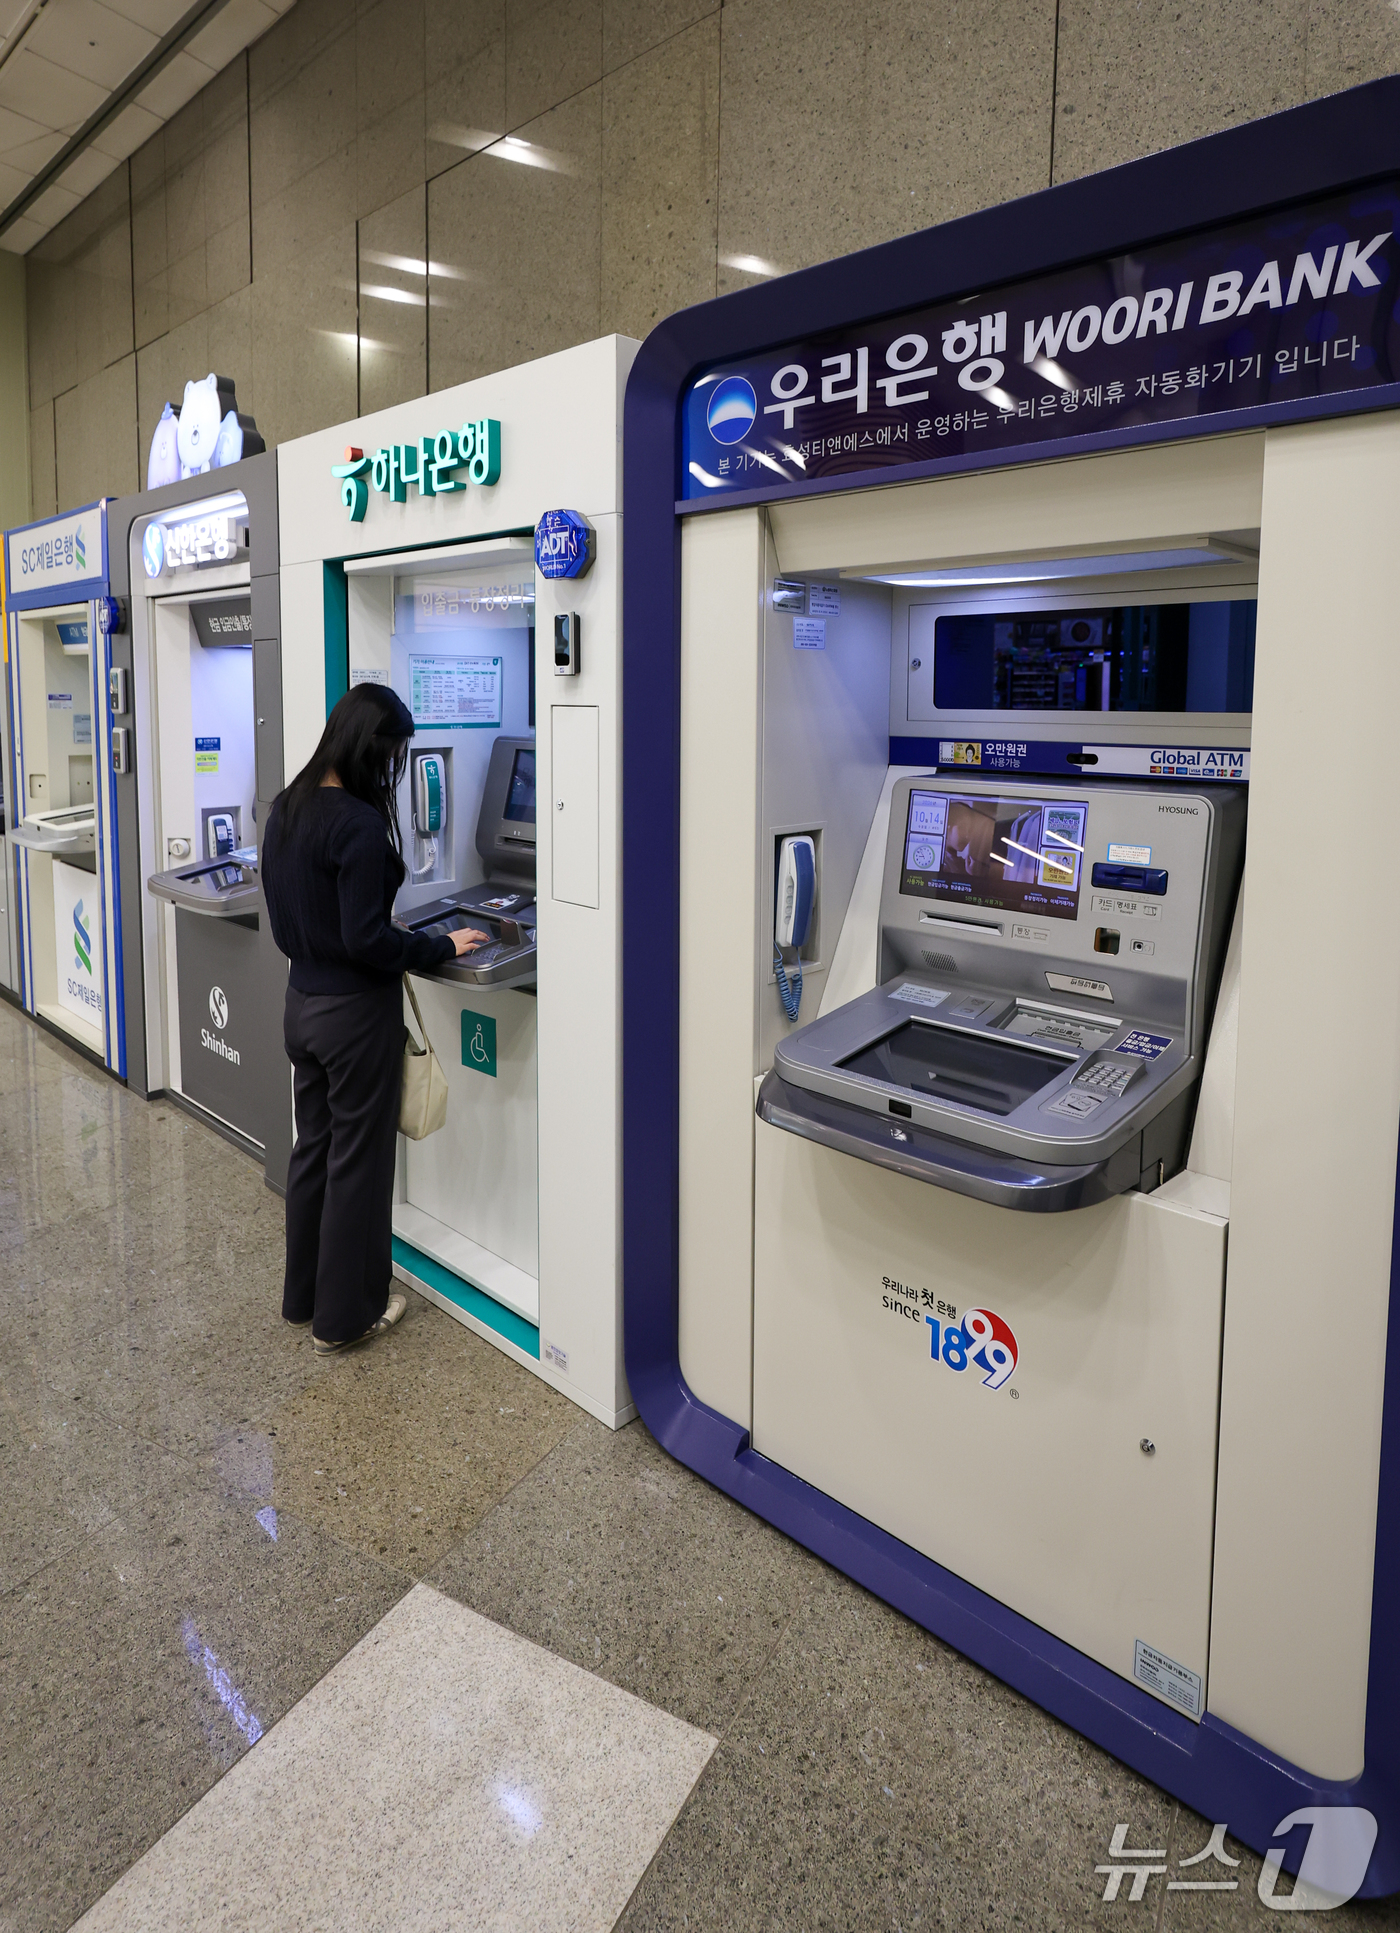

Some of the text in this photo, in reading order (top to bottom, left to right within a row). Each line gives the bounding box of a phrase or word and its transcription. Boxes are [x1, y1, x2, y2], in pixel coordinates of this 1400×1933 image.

[764, 231, 1393, 430] 우리은행 WOORI BANK
[717, 457, 730, 475] 본
[915, 409, 989, 439] 운영하는
[997, 380, 1126, 424] 우리은행제휴
[1134, 354, 1261, 398] 자동화기기
[1274, 335, 1360, 374] 입니다
[371, 418, 497, 503] 하나은행
[22, 534, 74, 575] SC제일은행
[166, 516, 230, 568] 신한은행
[541, 532, 569, 558] ADT
[985, 743, 1027, 757] 오만원권
[990, 758, 1021, 768] 사용가능
[1150, 750, 1244, 767] Global ATM
[1158, 805, 1199, 816] HYOSUNG
[1099, 899, 1137, 910] 카드 명세표
[201, 1027, 241, 1066] Shinhan
[882, 1276, 957, 1320] 우리나라 첫 은행
[924, 1306, 1020, 1393] 1899
